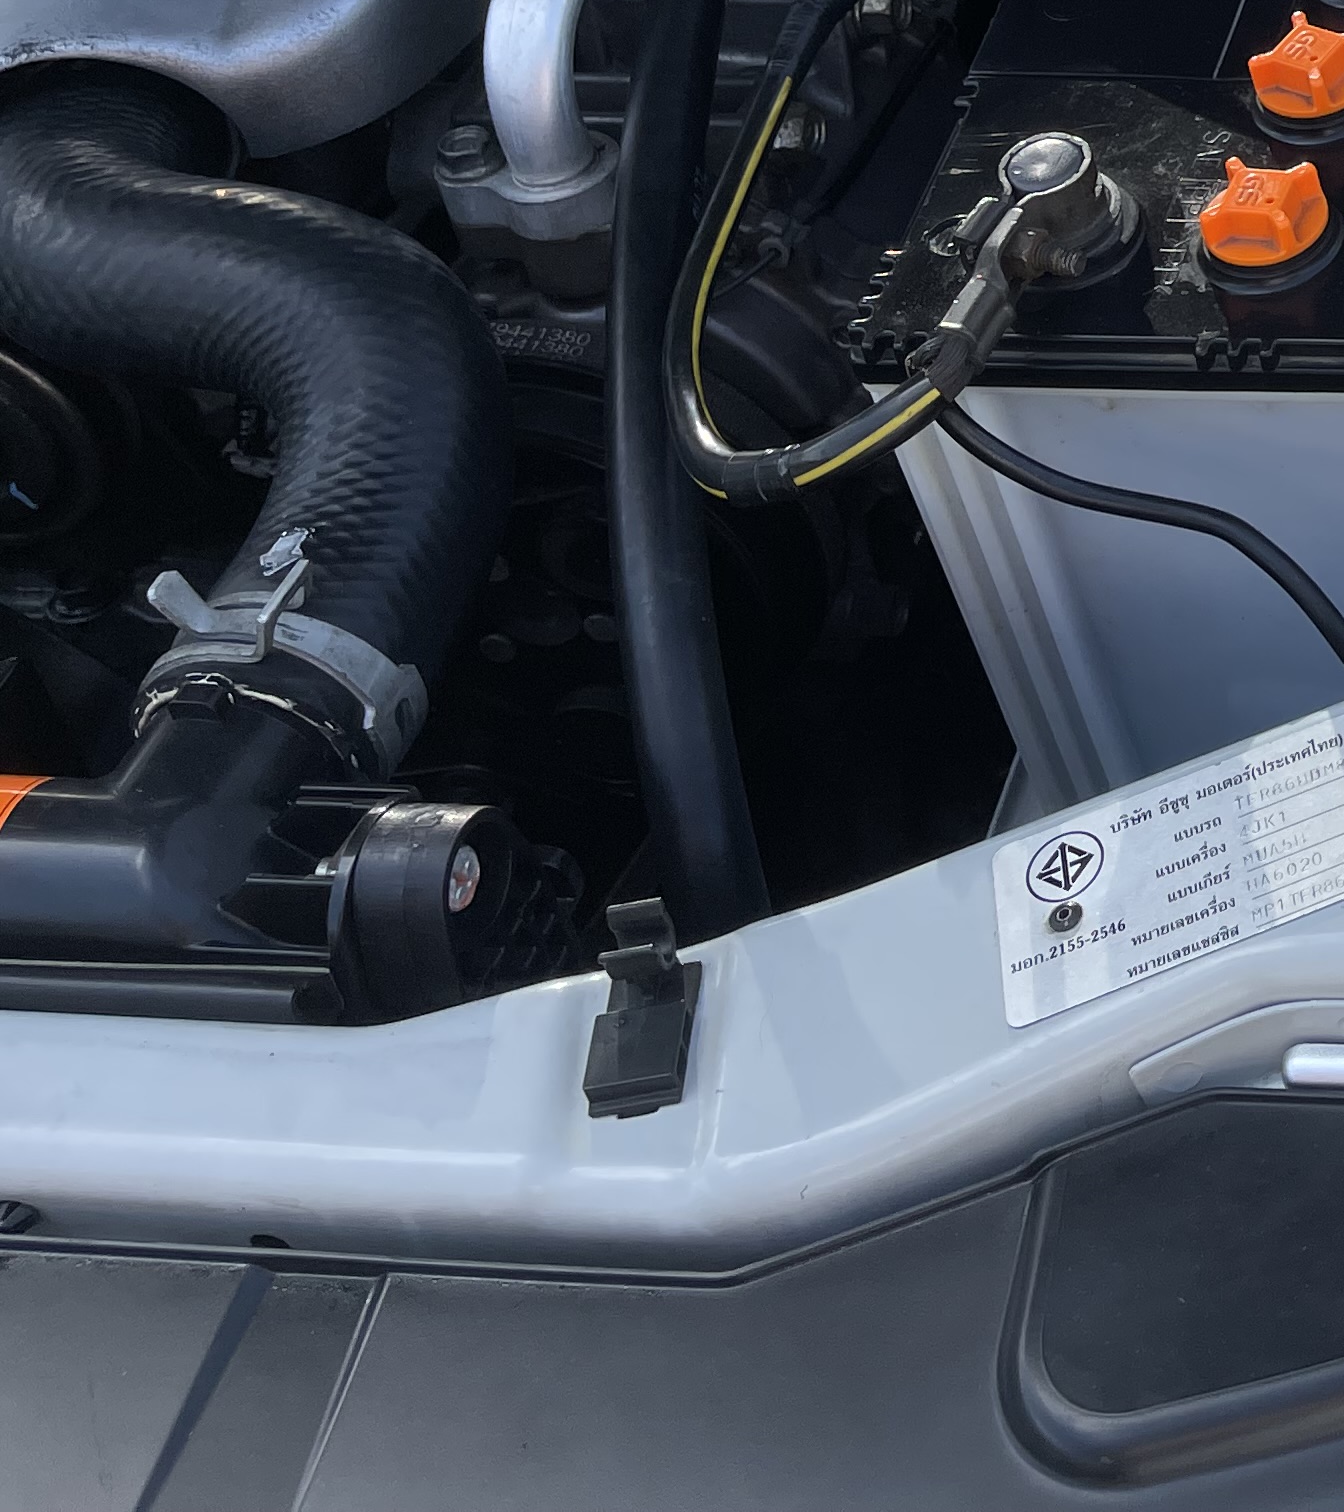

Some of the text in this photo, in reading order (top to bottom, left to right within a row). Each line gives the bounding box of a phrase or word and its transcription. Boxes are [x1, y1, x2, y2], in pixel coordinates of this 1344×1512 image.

[1235, 173, 1267, 206] GS
[1110, 808, 1152, 833] บริษัท
[1158, 793, 1190, 818] อีซูซุ
[1174, 817, 1221, 842] แบบรถ
[1156, 812, 1285, 878] แบบเครื่อง 4JK1
[1168, 864, 1230, 902] แบบเกียร์
[1131, 895, 1235, 946] หมายเลขเครื่อง
[1011, 920, 1125, 973] มอก.2155-2546
